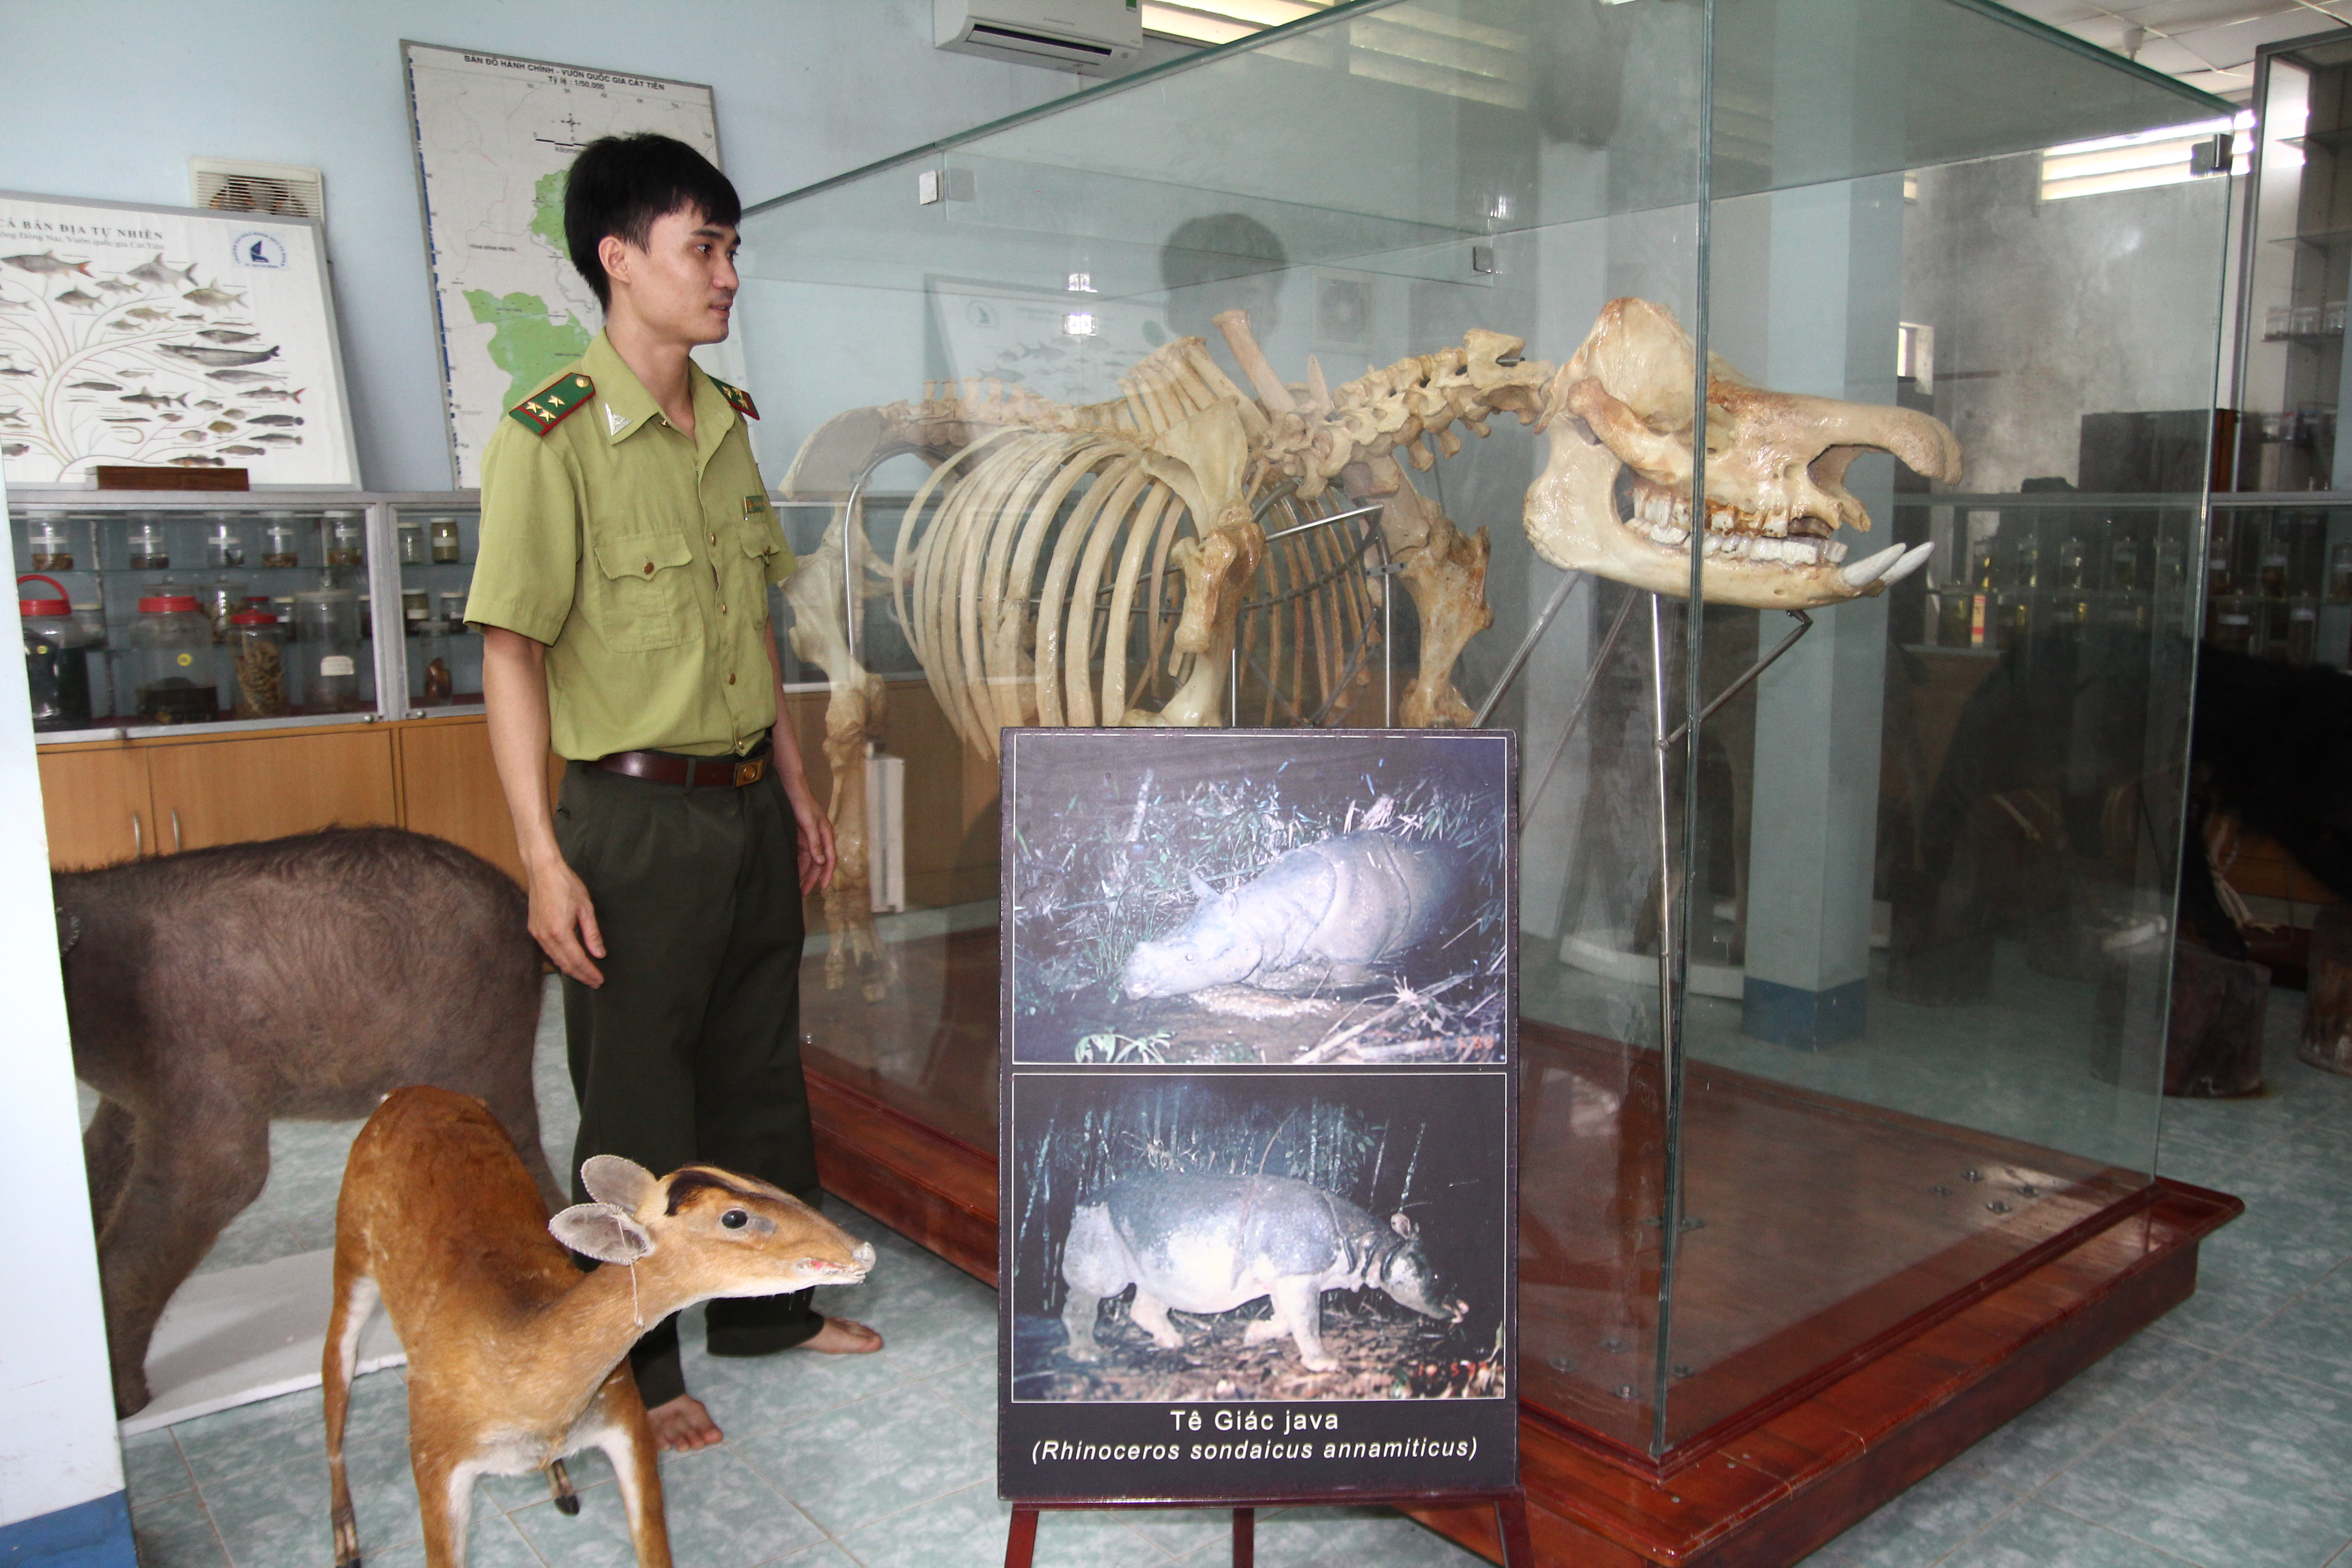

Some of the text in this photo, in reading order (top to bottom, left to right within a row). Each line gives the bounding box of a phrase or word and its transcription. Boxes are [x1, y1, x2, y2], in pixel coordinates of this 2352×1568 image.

[60, 225, 86, 235] ĐỊA
[118, 229, 162, 239] NHIÊN
[1170, 1410, 1338, 1434] Tê Giác java
[1032, 1437, 1477, 1465] (Rhinoceros sondaicus annamiticus)
